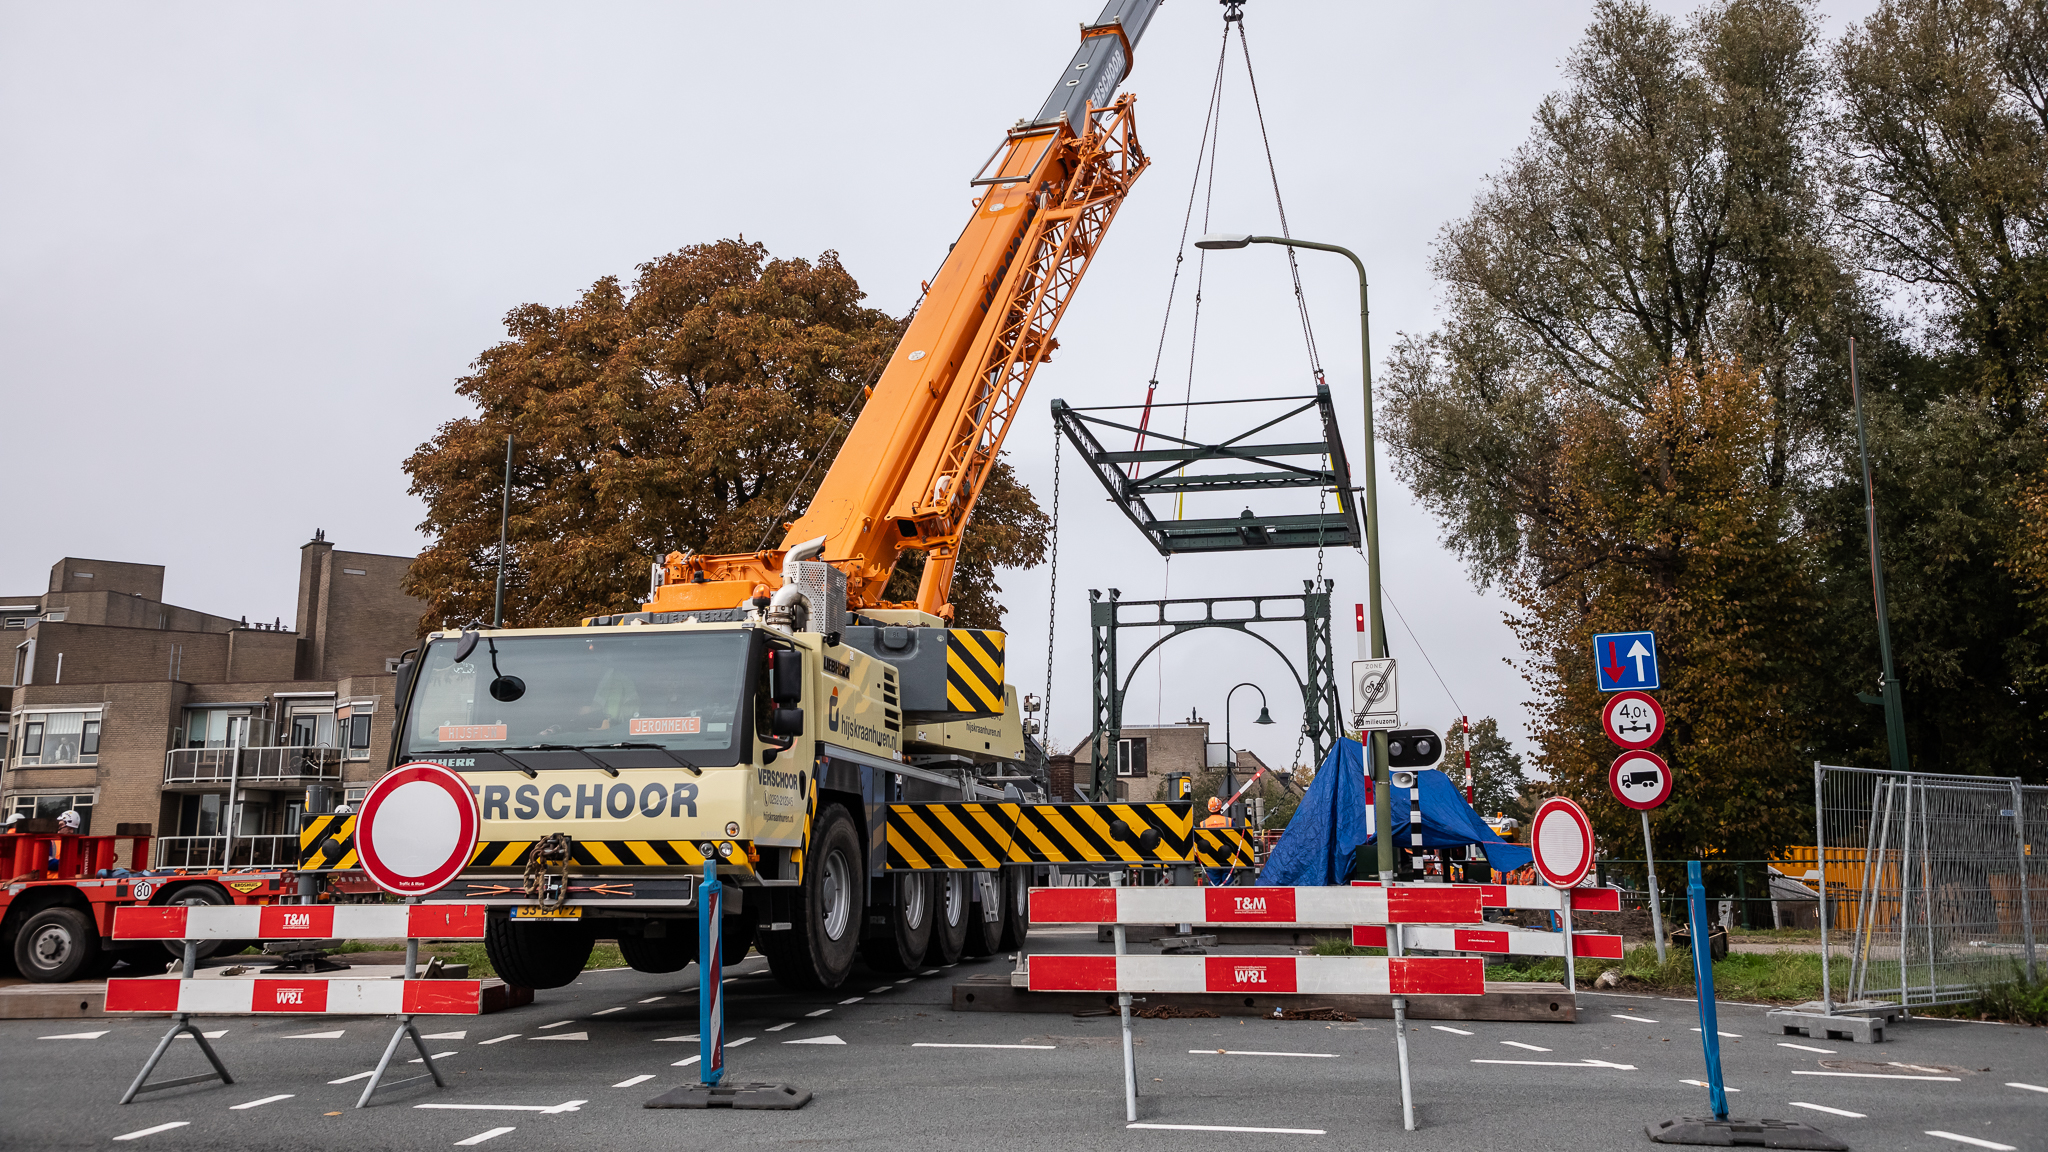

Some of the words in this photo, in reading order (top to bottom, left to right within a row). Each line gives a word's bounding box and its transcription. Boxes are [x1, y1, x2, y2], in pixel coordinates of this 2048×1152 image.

[1091, 50, 1123, 116] ERSCHOOR
[823, 656, 850, 680] LIEBHERR
[635, 719, 695, 732] JEROMMEKE
[841, 714, 898, 750] hijskraanhuren.nl
[965, 721, 1002, 738] hijskraanhuren.nl
[448, 727, 498, 739] HIJSFIJN
[757, 768, 798, 790] VERSCHOOR
[472, 782, 699, 820] RSCHOOR
[136, 885, 149, 897] 80
[1234, 897, 1267, 910] T&M
[283, 913, 310, 925] T&M
[1234, 970, 1267, 983] T&M
[276, 992, 303, 1004] T&M
